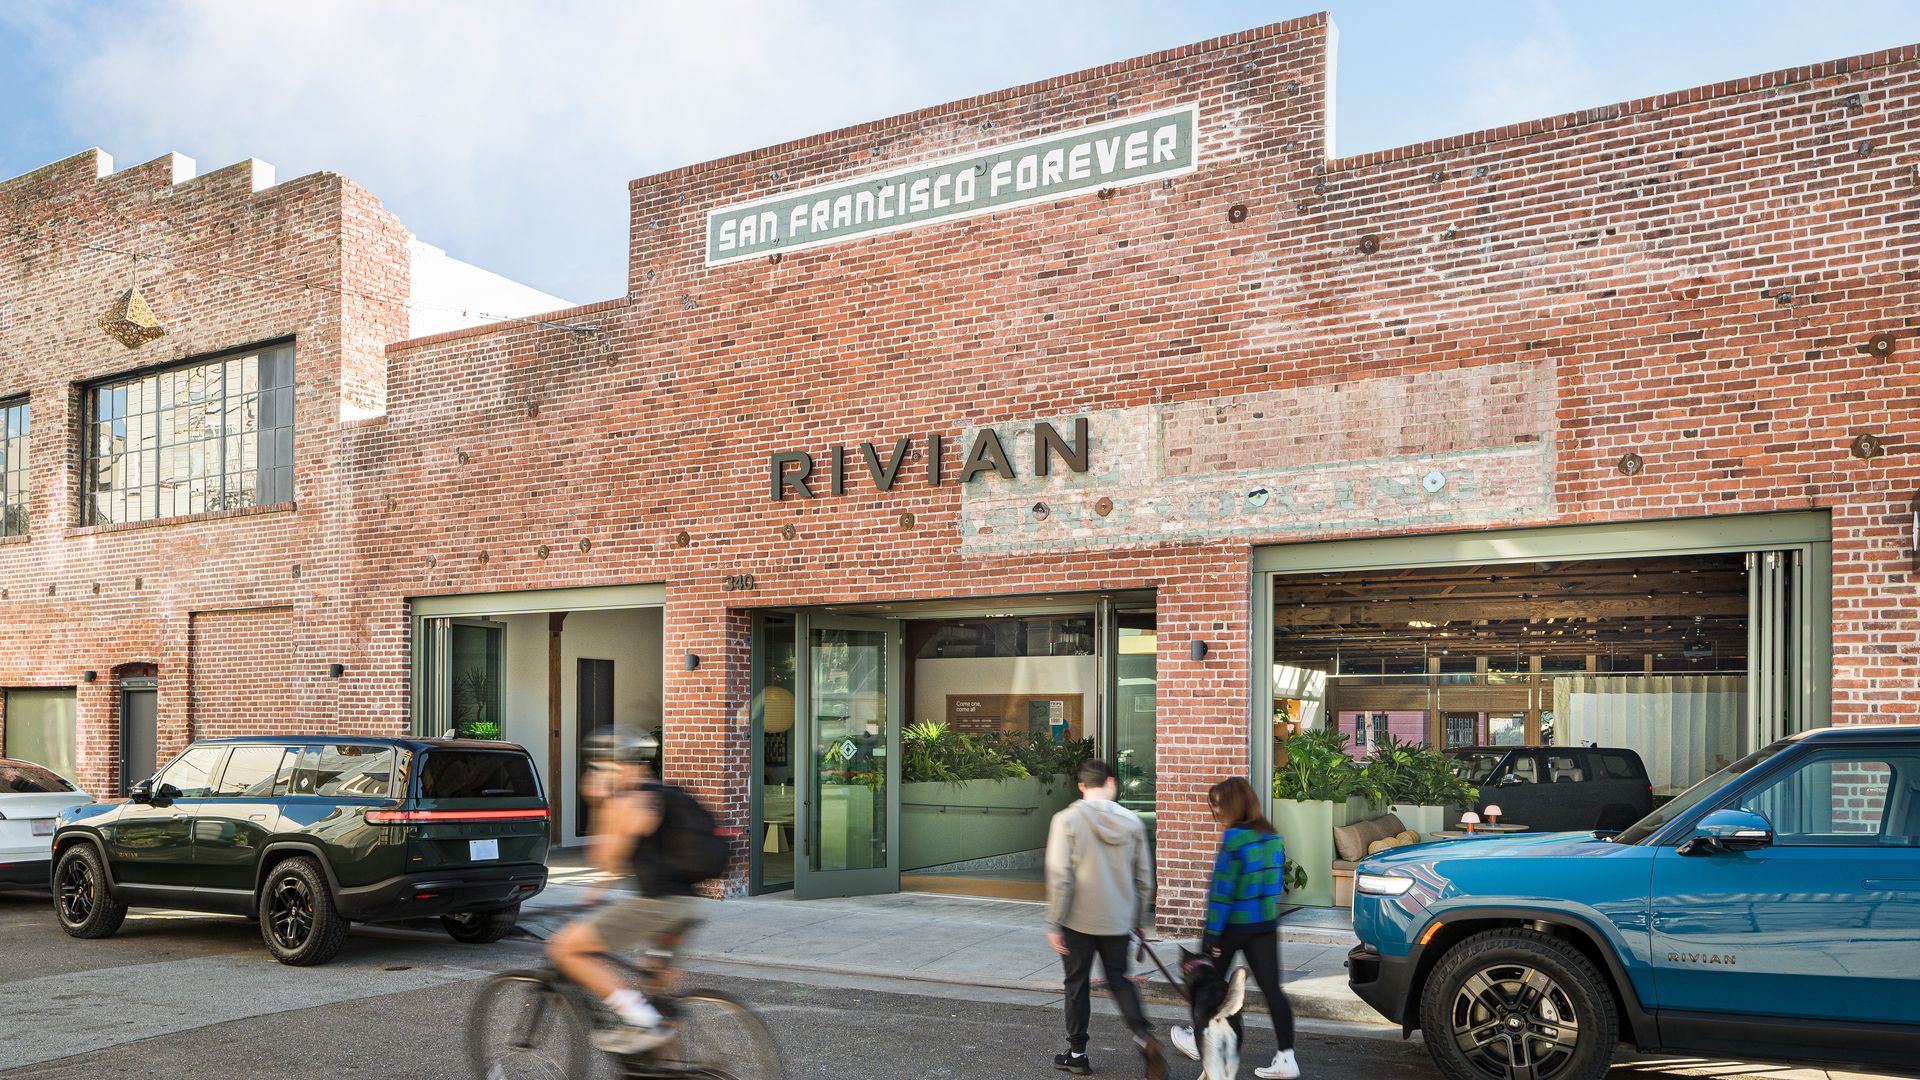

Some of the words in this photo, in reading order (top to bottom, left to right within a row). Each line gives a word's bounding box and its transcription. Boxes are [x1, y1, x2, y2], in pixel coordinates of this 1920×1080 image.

[719, 210, 777, 252] SAN
[790, 167, 975, 237] FRANCISCO
[991, 124, 1176, 196] FOREVER
[771, 417, 1088, 501] RIVIAN
[723, 573, 754, 591] 340
[1668, 952, 1736, 965] RIVIAN
